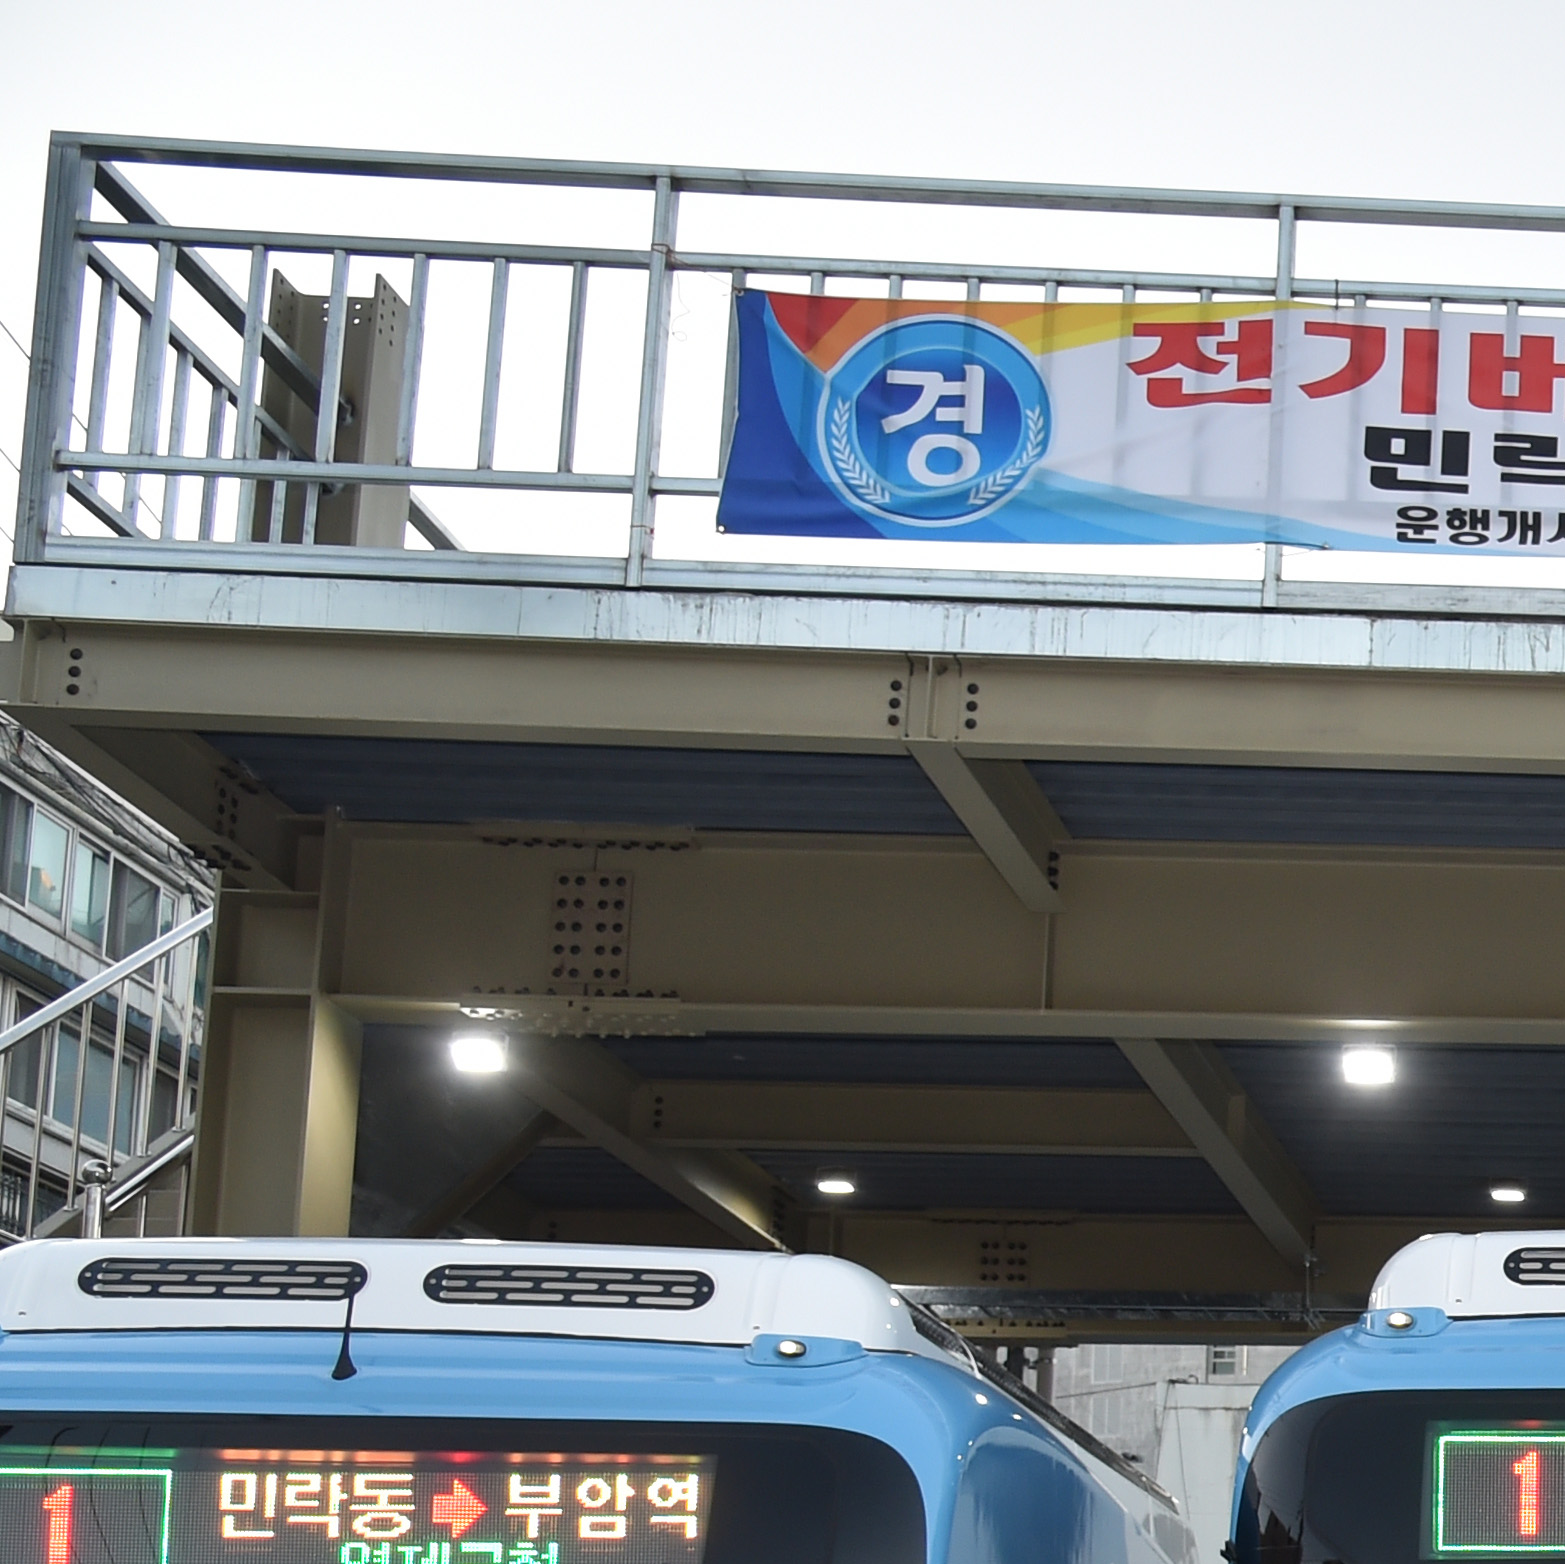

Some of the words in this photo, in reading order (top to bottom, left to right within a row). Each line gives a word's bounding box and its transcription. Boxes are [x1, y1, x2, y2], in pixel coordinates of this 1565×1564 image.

[881, 363, 985, 488] 경
[218, 1472, 416, 1540] 민락동
[504, 1472, 699, 1540] 부암역
[1512, 1450, 1540, 1537] 1
